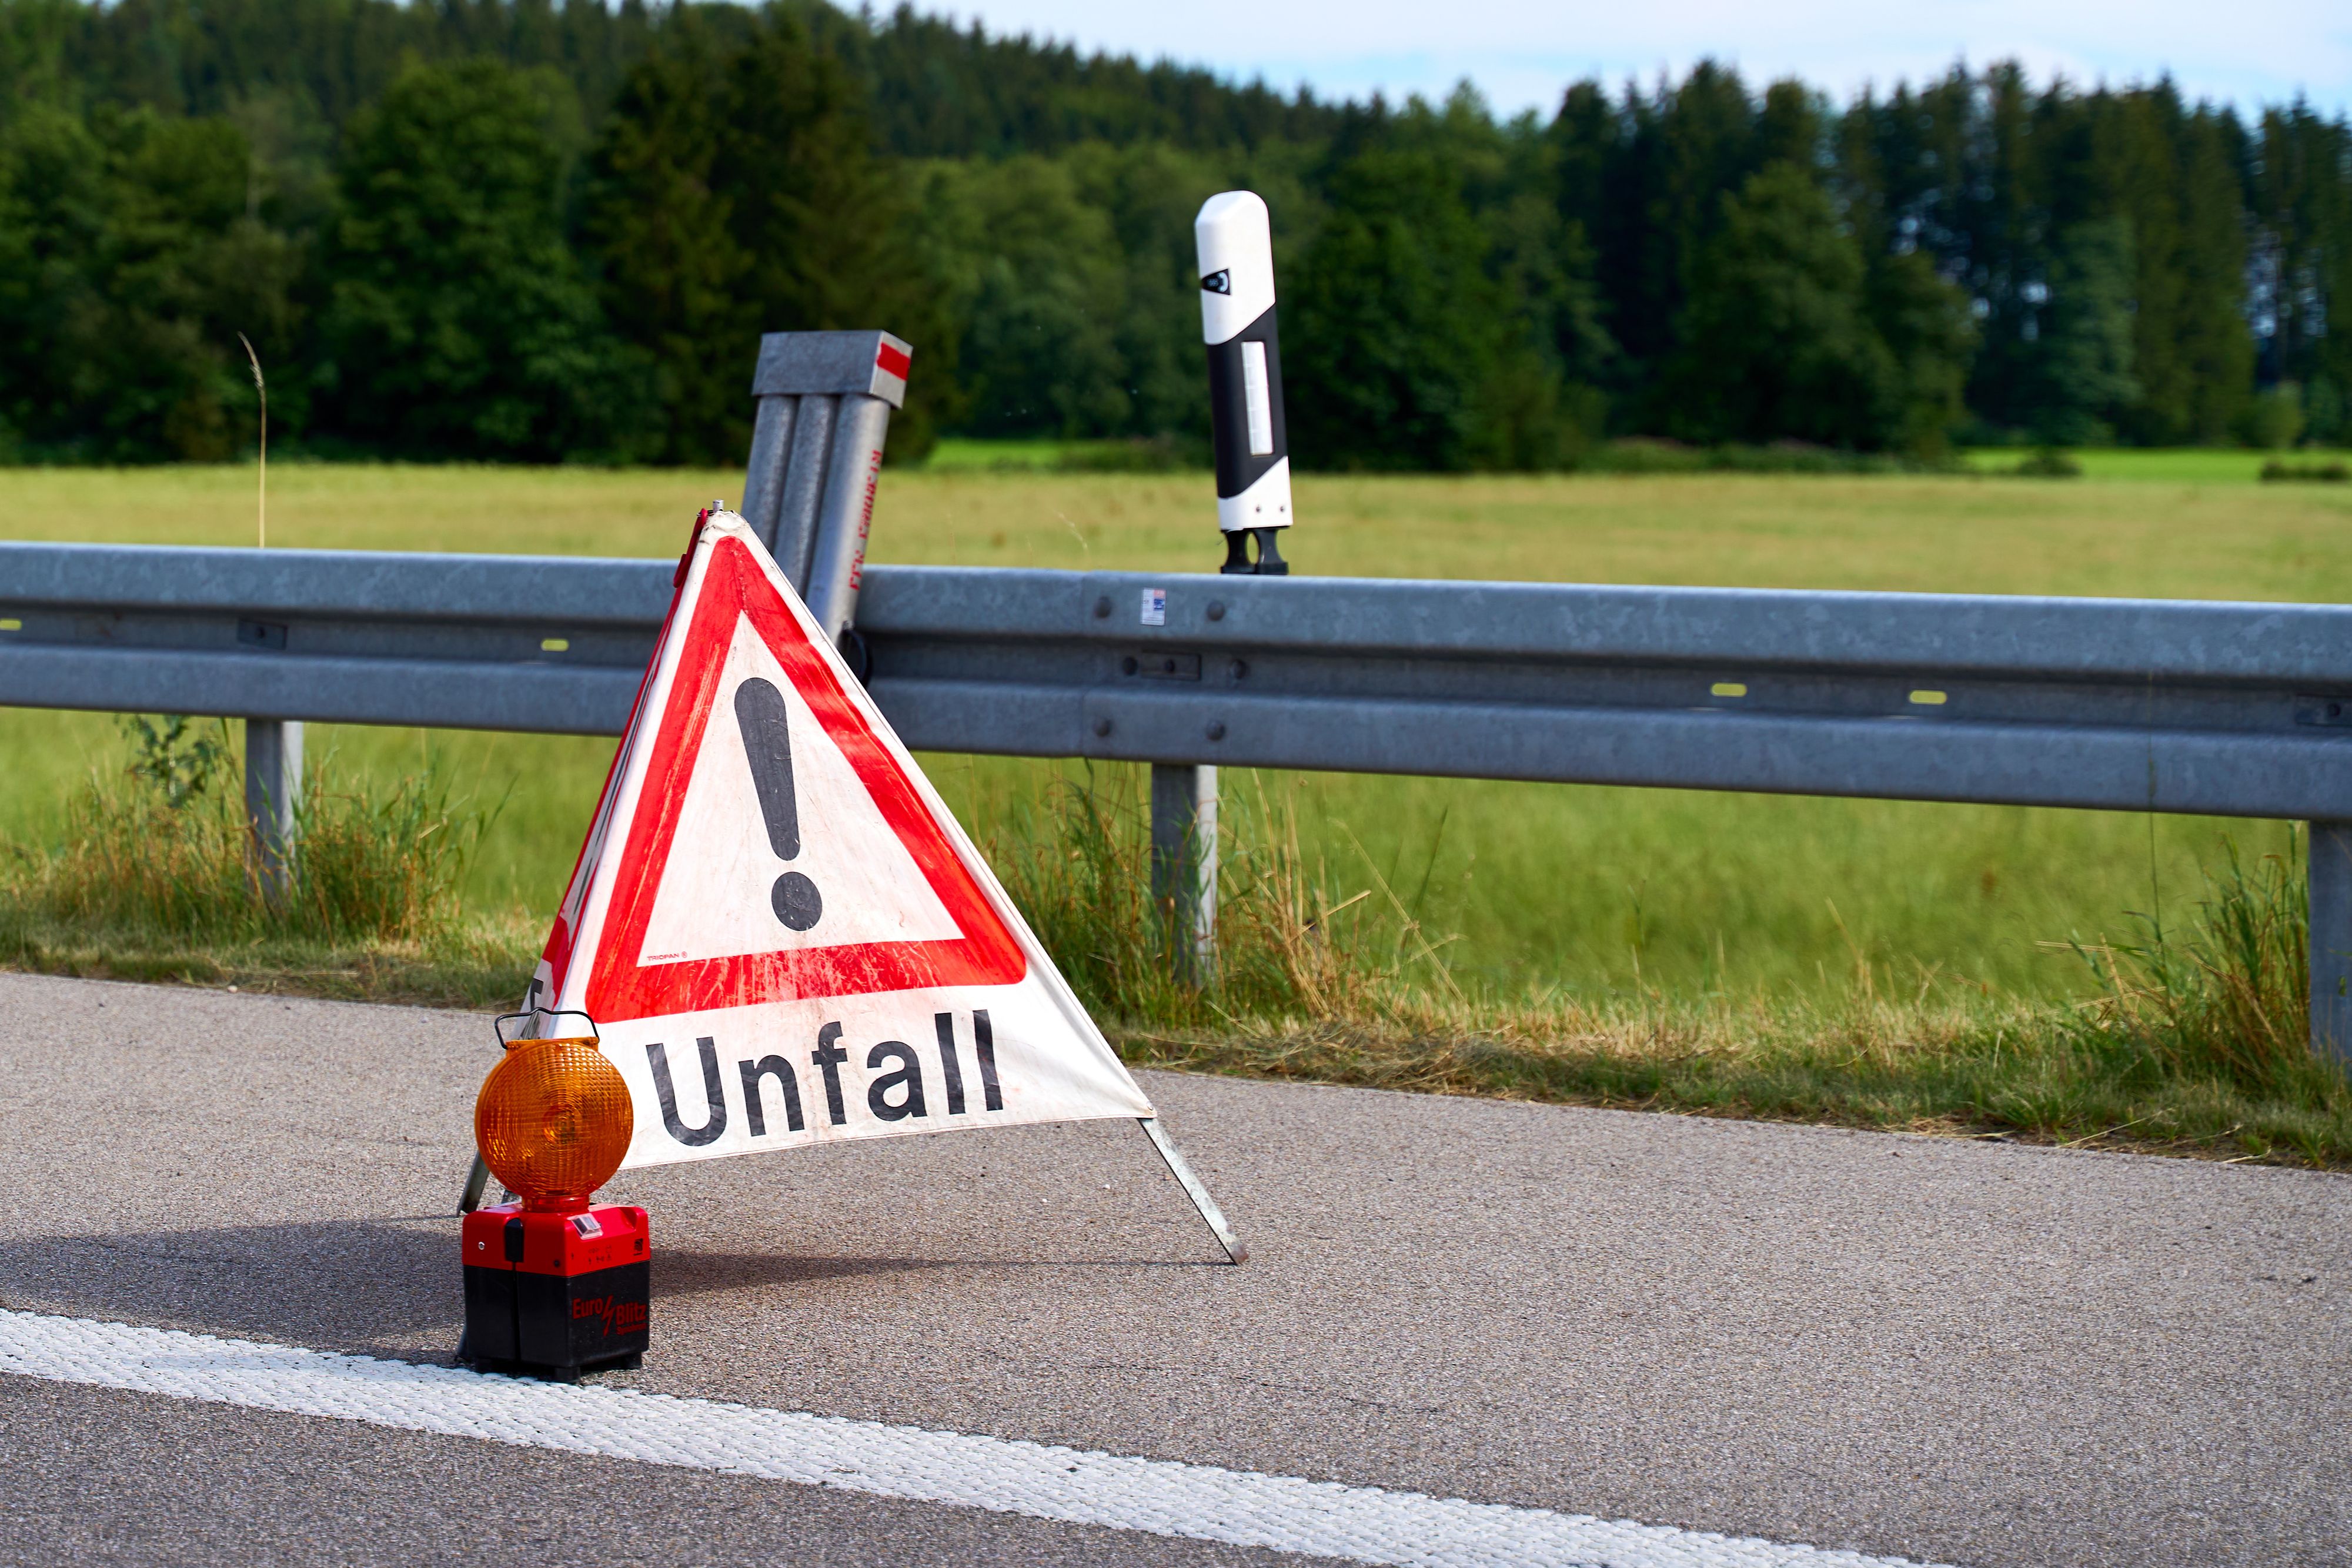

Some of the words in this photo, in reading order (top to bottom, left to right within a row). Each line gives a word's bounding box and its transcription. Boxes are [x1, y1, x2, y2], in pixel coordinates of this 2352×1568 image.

[647, 953, 679, 961] TRIOPAN
[646, 1009, 1003, 1146] Unfall
[572, 1298, 603, 1319] Euro
[616, 1302, 646, 1325] Blitz
